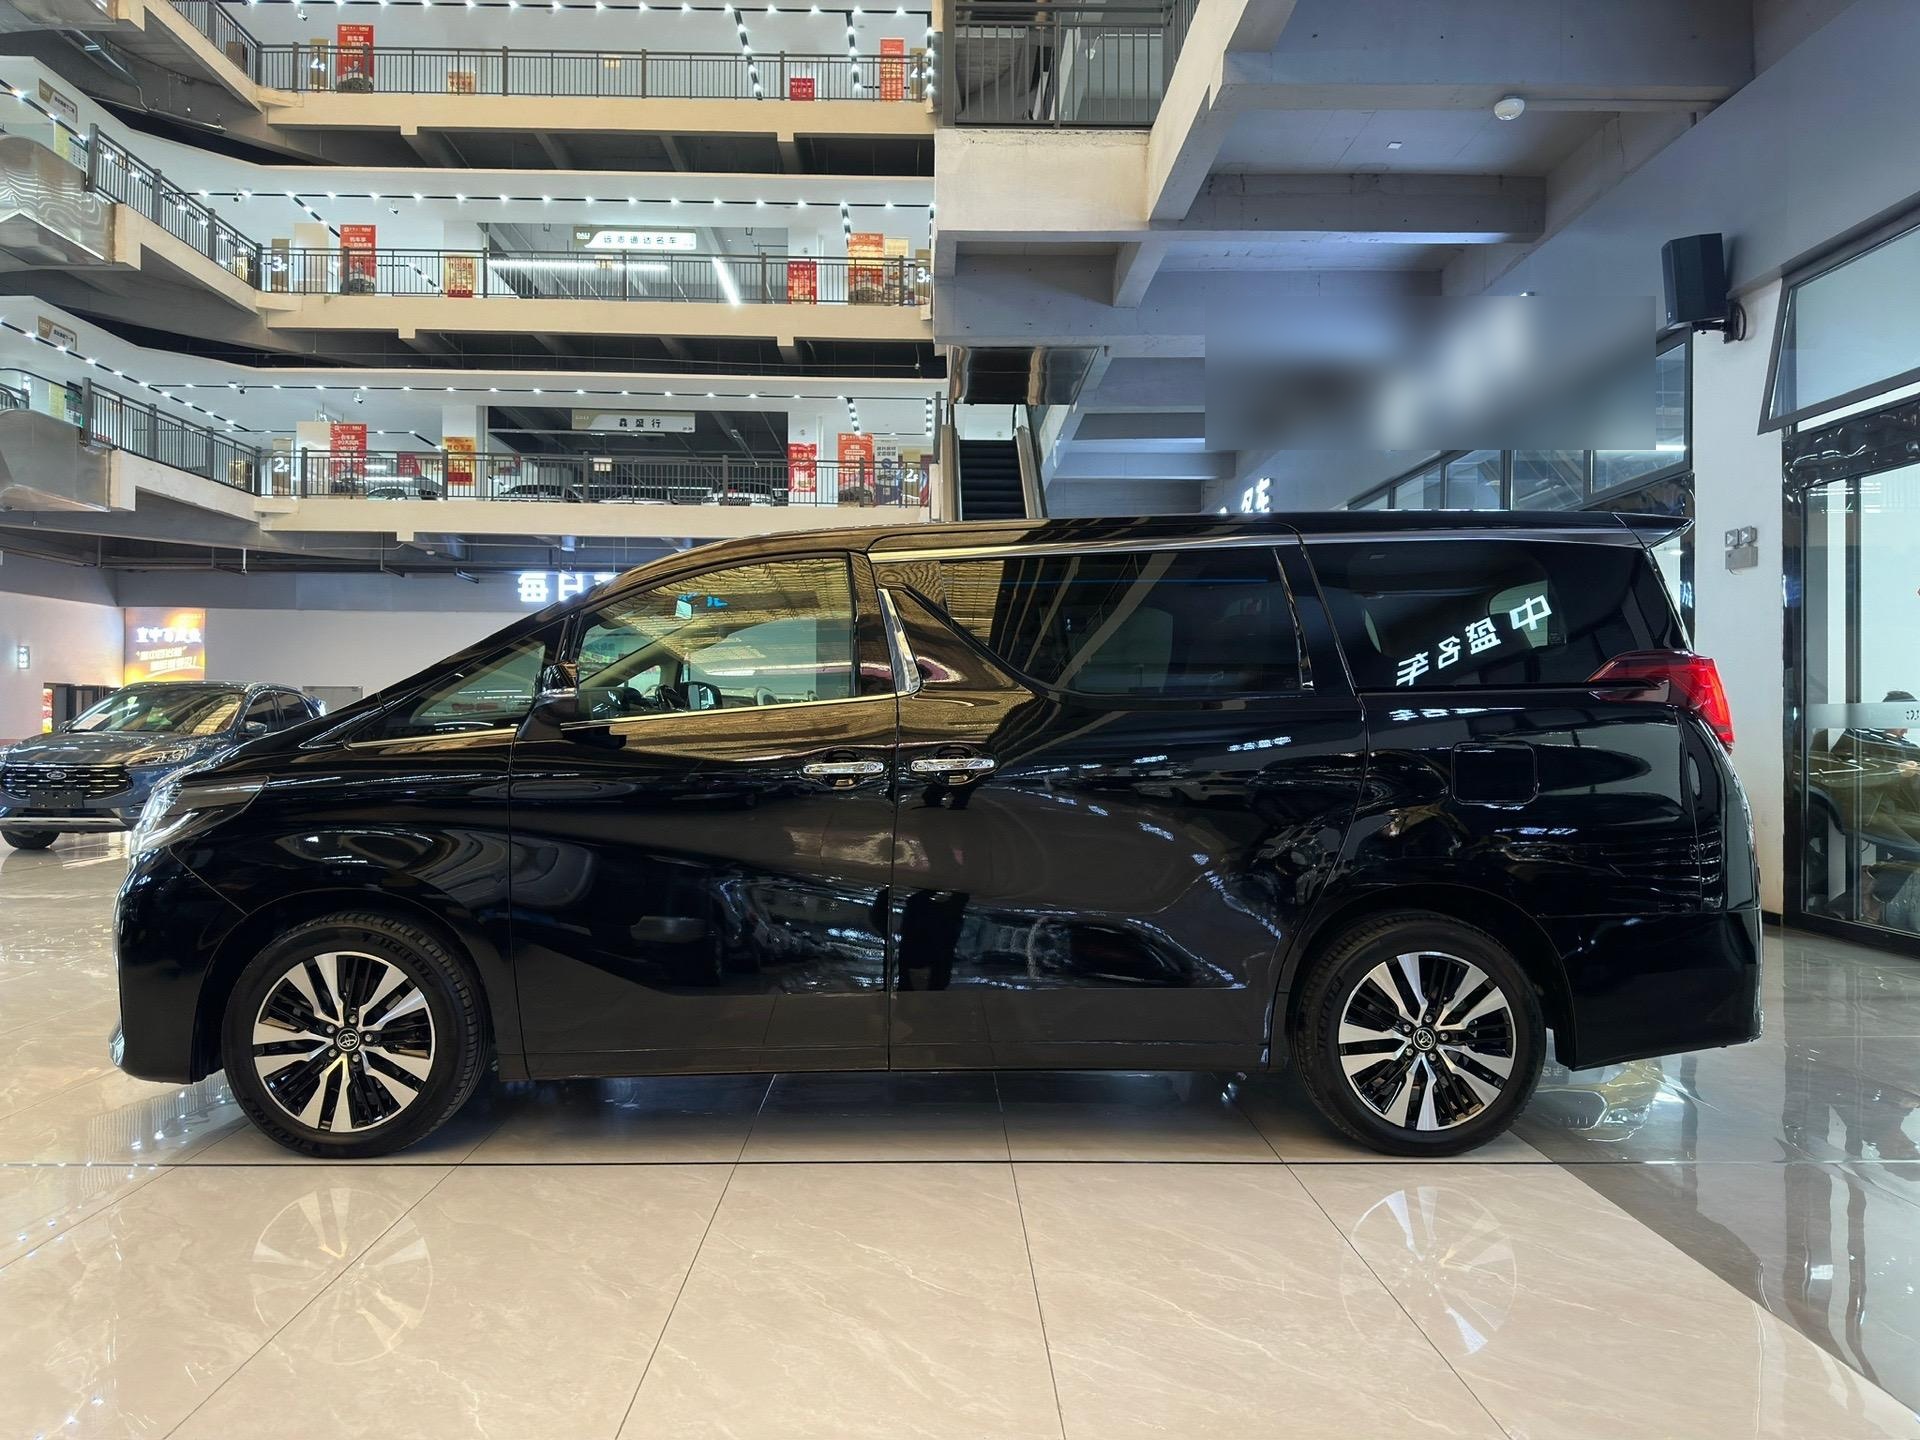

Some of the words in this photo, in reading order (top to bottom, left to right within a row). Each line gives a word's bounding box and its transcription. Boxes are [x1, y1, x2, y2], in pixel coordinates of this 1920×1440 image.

[271, 255, 288, 272] 3F
[916, 267, 931, 283] 3F
[274, 457, 290, 473] 2F
[904, 468, 919, 482] 2F
